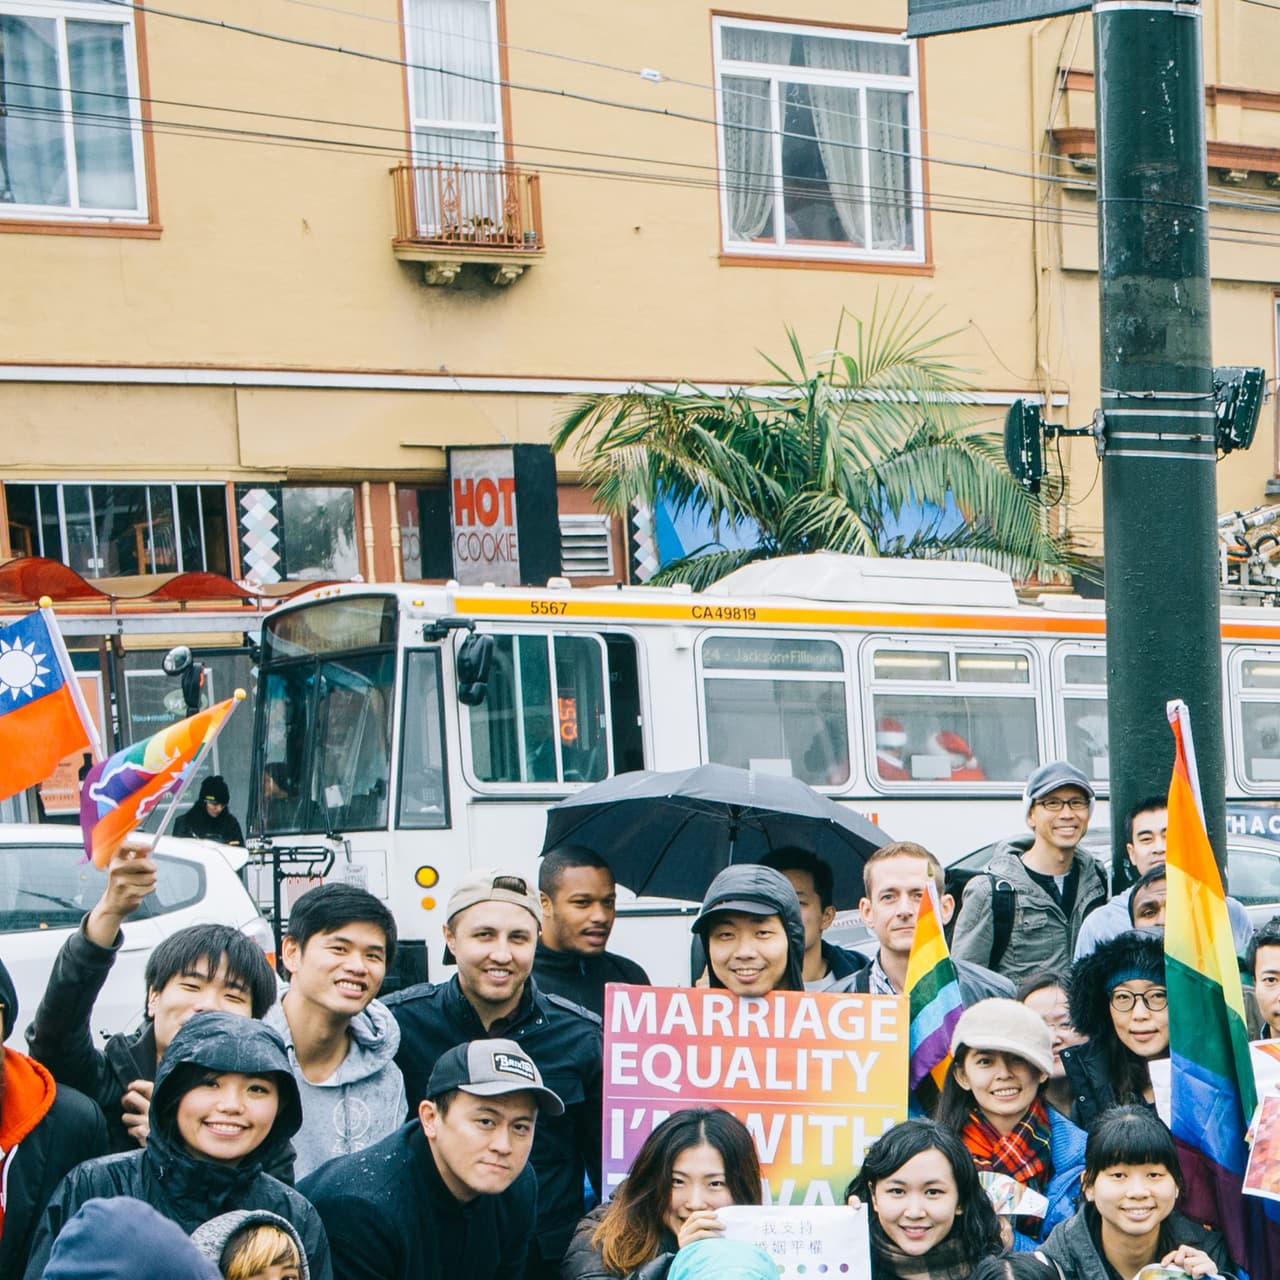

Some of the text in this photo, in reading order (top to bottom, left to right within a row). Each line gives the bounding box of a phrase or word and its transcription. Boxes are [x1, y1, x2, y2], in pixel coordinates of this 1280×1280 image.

[454, 478, 516, 526] HOT
[456, 533, 517, 562] COOKIE
[530, 601, 568, 615] 5567
[691, 605, 757, 621] CA49819
[1251, 815, 1266, 834] A
[611, 991, 898, 1042] MARRIAGE
[611, 1042, 880, 1093] EQUALITY
